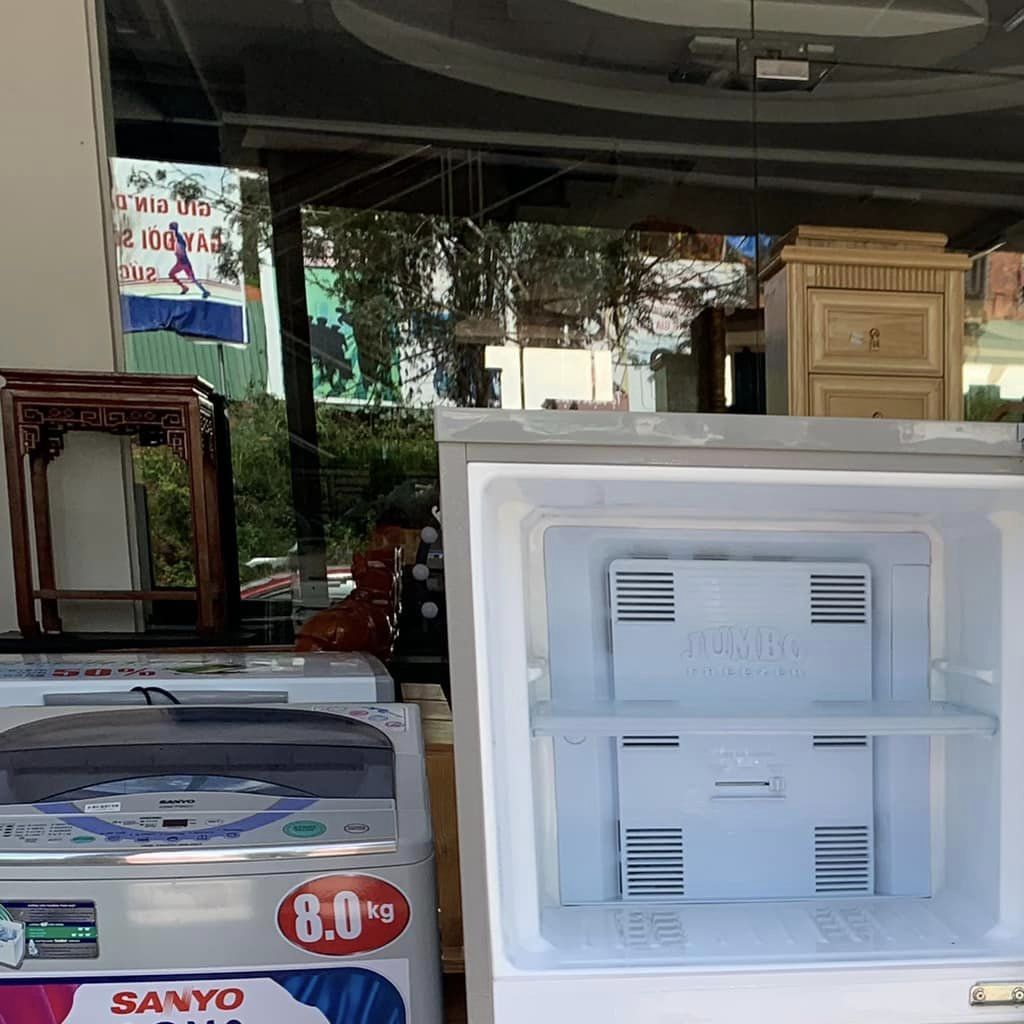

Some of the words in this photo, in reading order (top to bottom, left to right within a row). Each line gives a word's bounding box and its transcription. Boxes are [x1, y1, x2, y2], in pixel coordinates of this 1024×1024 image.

[293, 890, 362, 943] 8.0
[366, 901, 395, 924] kg
[110, 987, 245, 1015] SANYO
